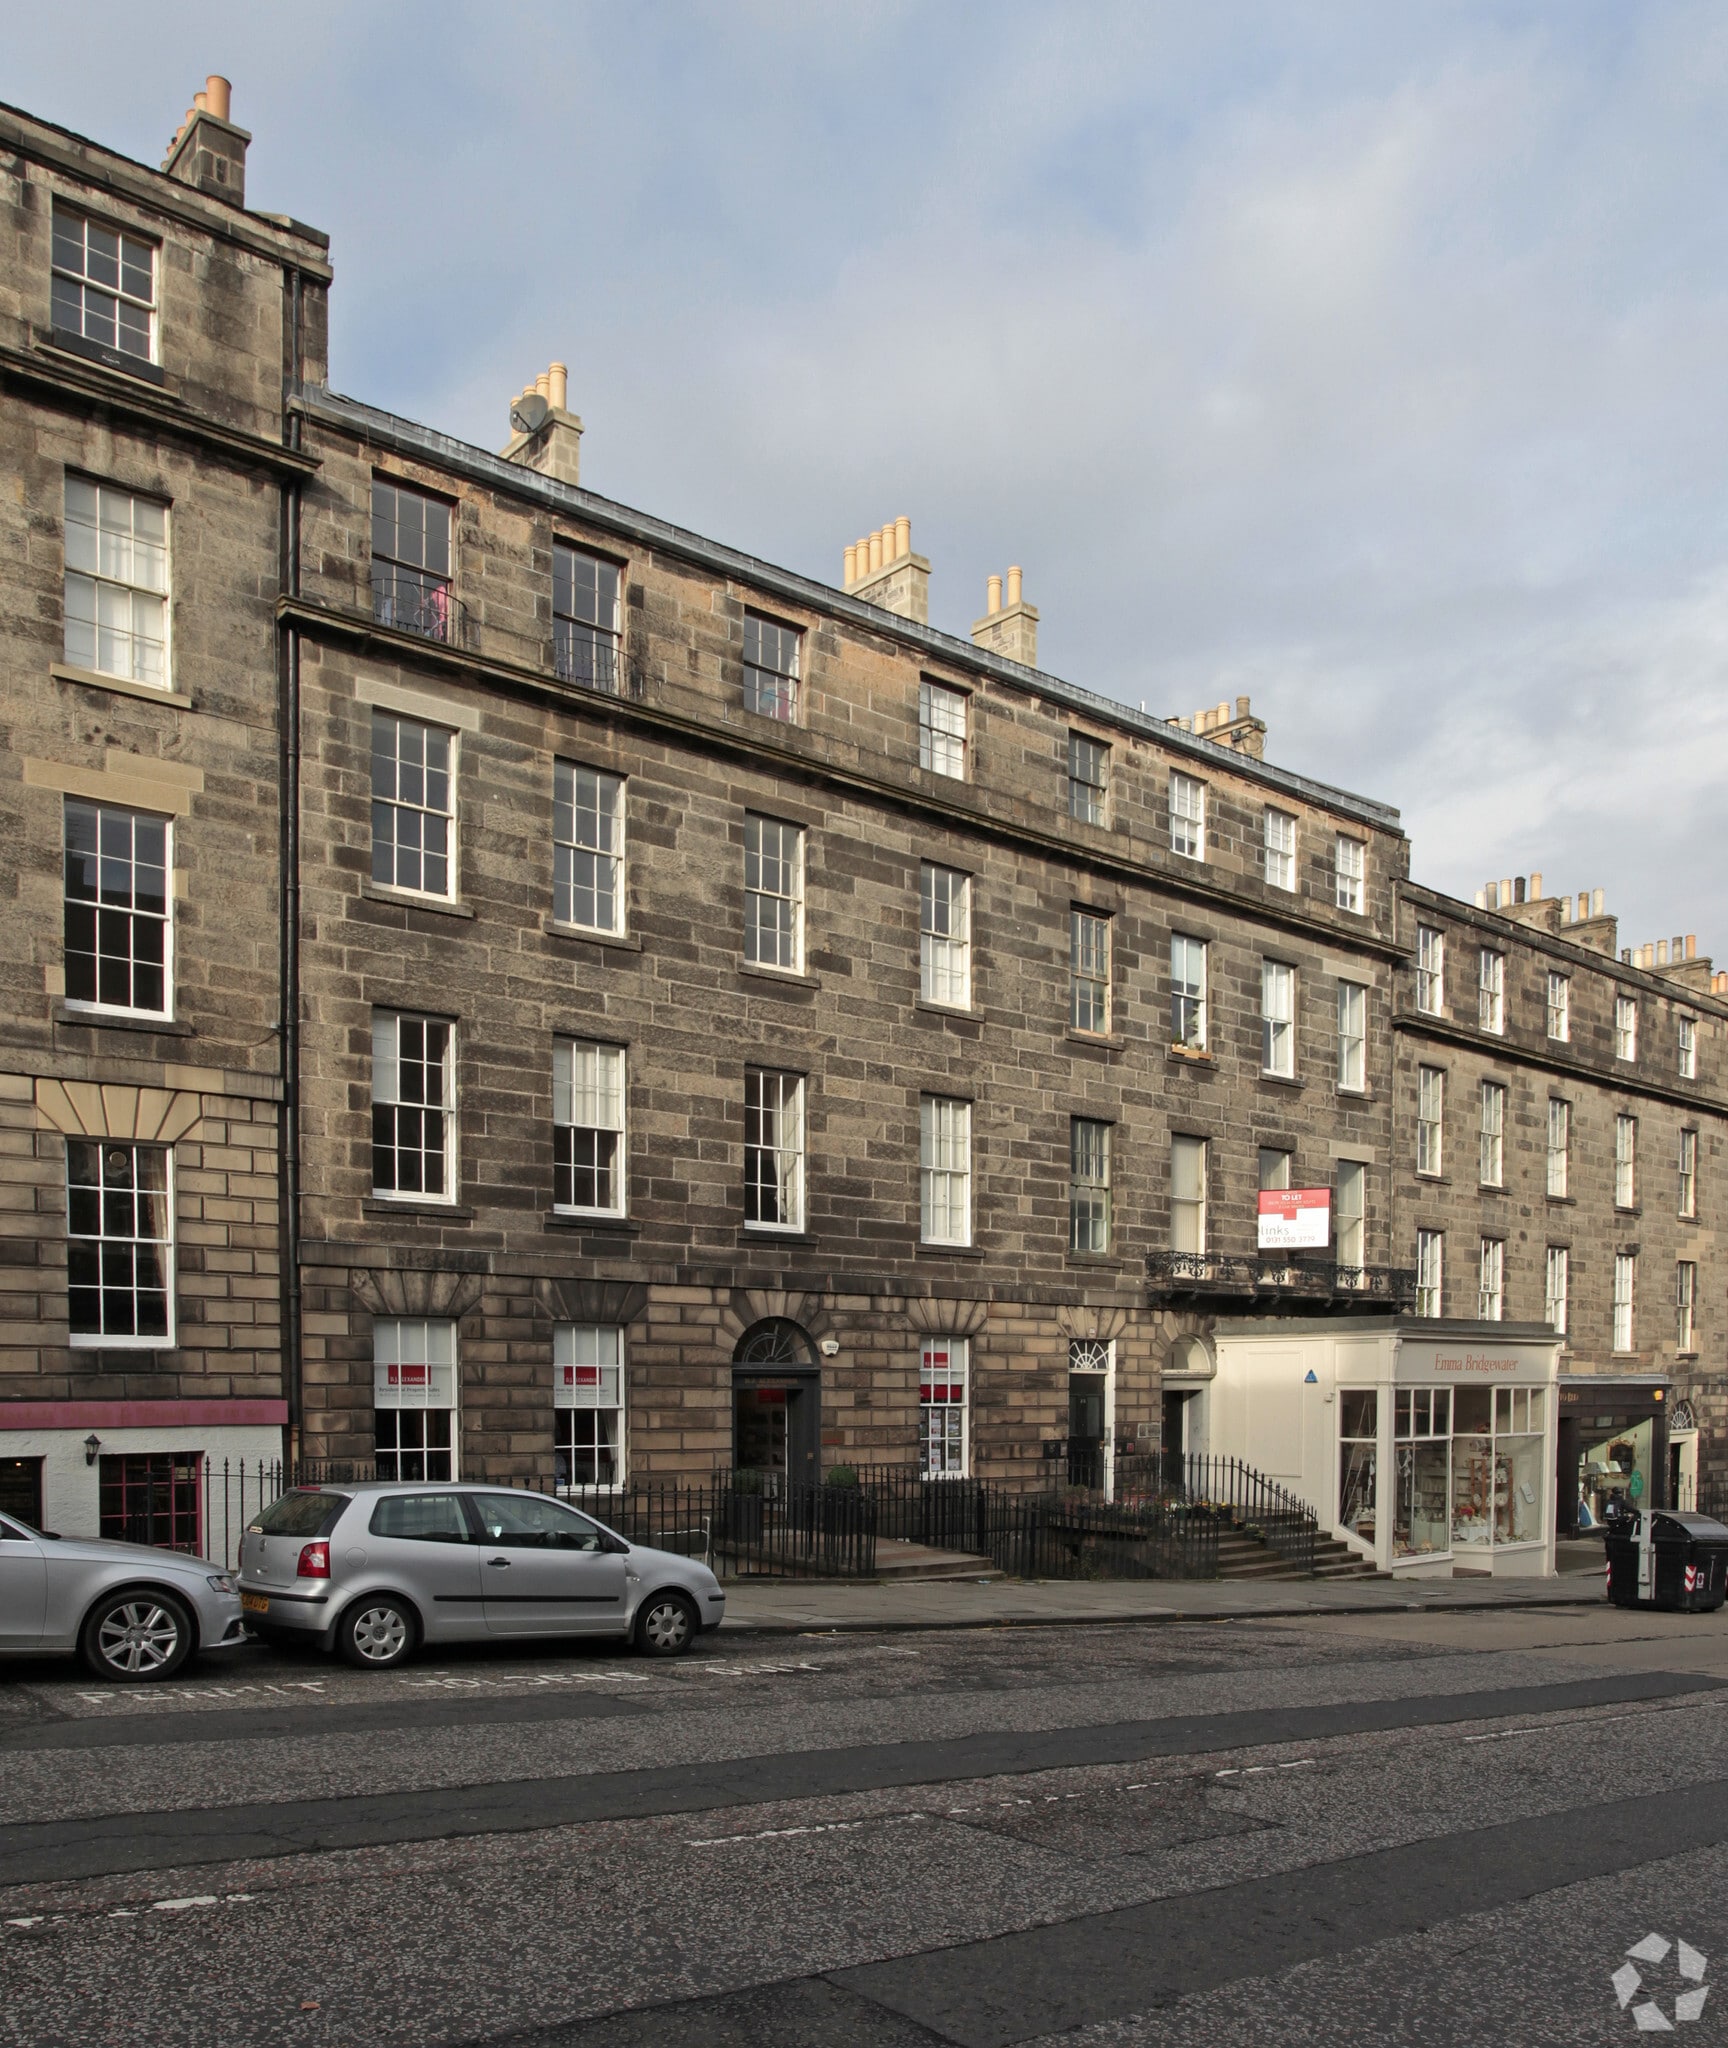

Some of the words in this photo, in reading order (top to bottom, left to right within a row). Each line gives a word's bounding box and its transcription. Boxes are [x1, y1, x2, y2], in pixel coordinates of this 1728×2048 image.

[1261, 1225, 1289, 1236] links
[1434, 1353, 1462, 1371] Emma
[1465, 1353, 1518, 1374] Bridgewater
[73, 1681, 327, 1705] PERMIT
